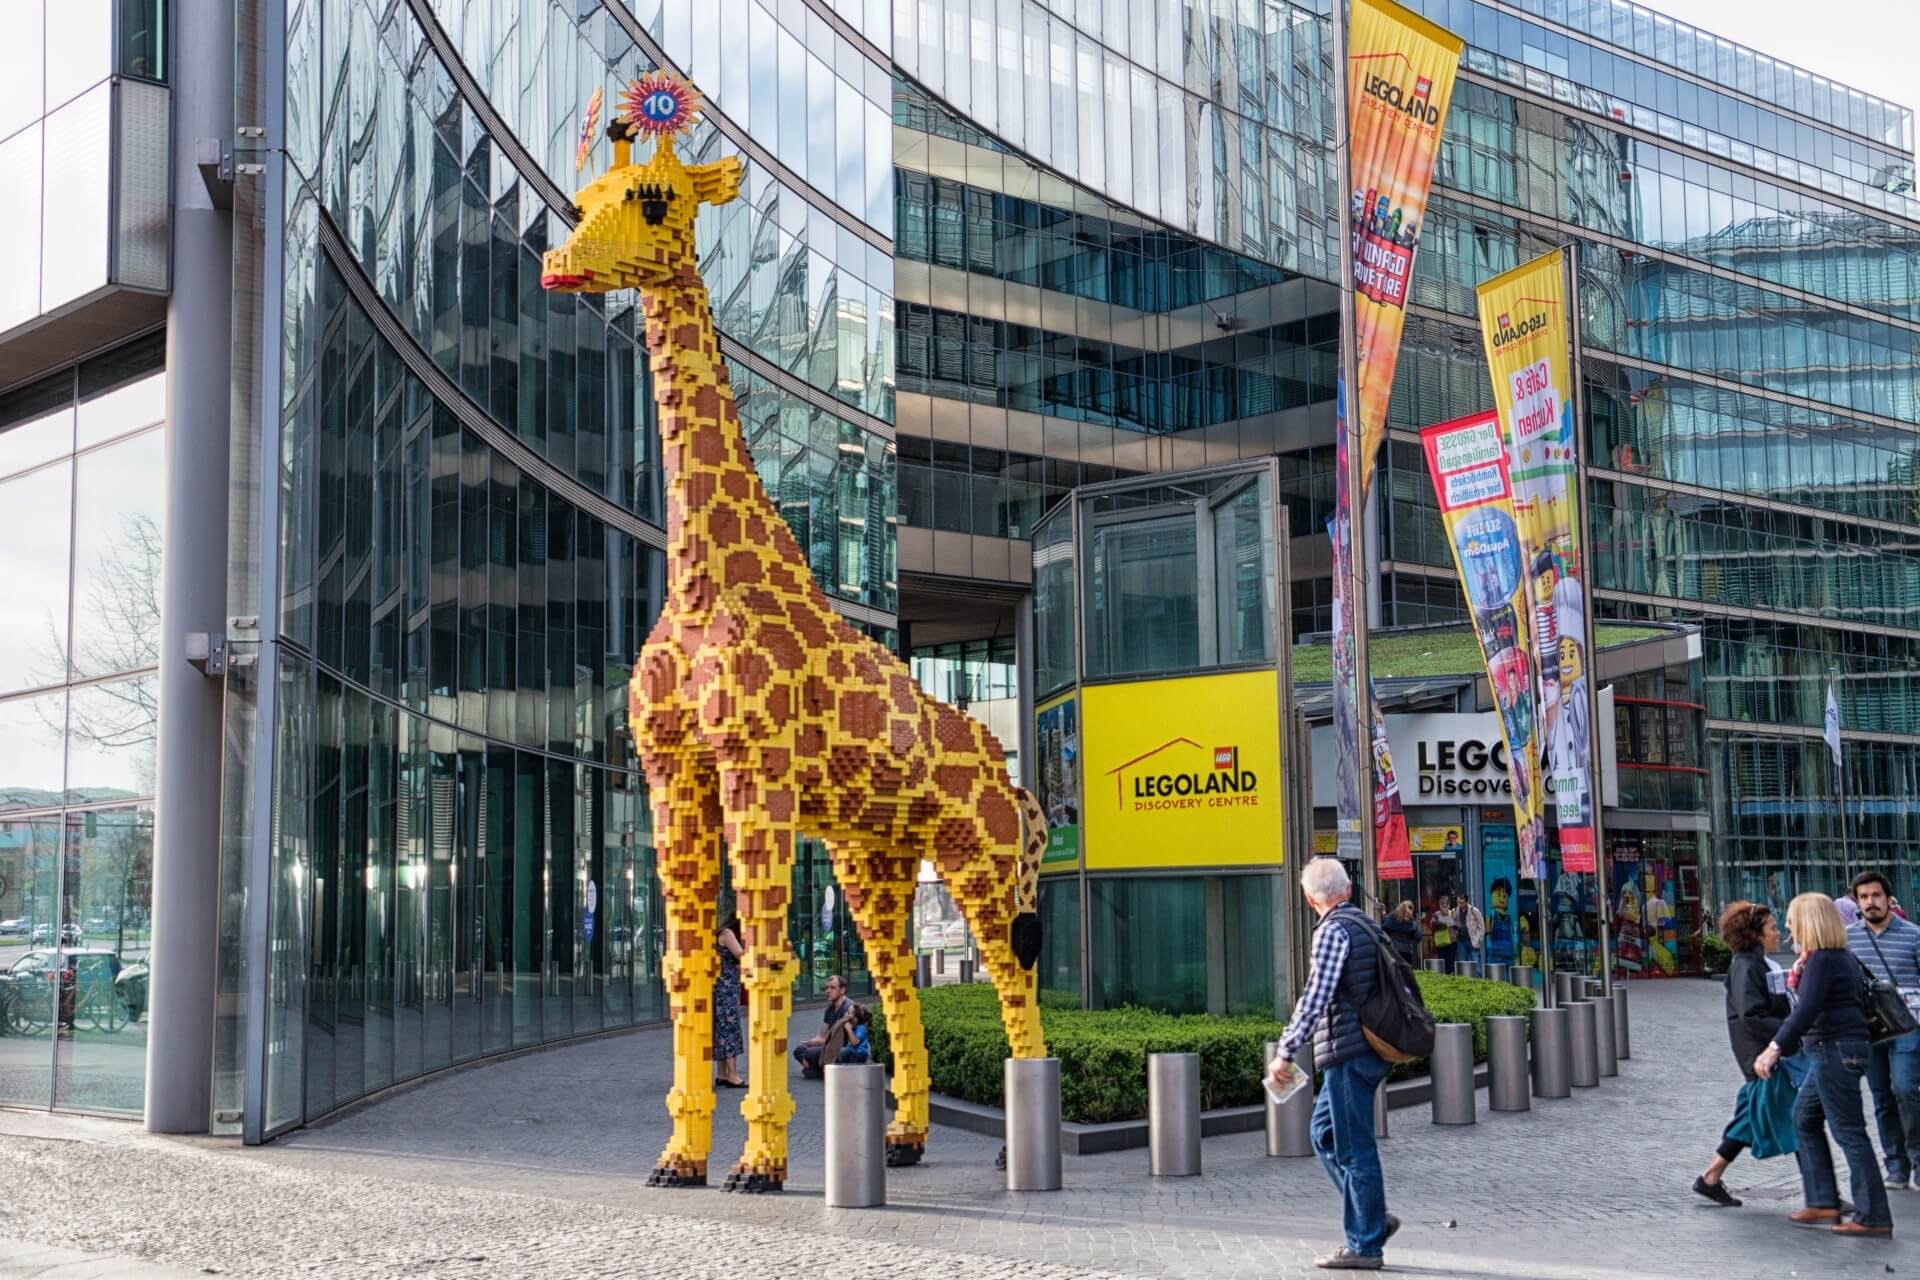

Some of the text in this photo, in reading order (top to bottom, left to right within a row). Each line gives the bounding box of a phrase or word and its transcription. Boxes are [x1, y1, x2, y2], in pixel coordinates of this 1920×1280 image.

[644, 94, 675, 115] 10
[1364, 71, 1439, 125] LEGOLAND
[1135, 746, 1257, 798] LEGOLAND
[1419, 774, 1512, 795] Discove
[1135, 796, 1258, 811] DISCOVERY CENTRE
